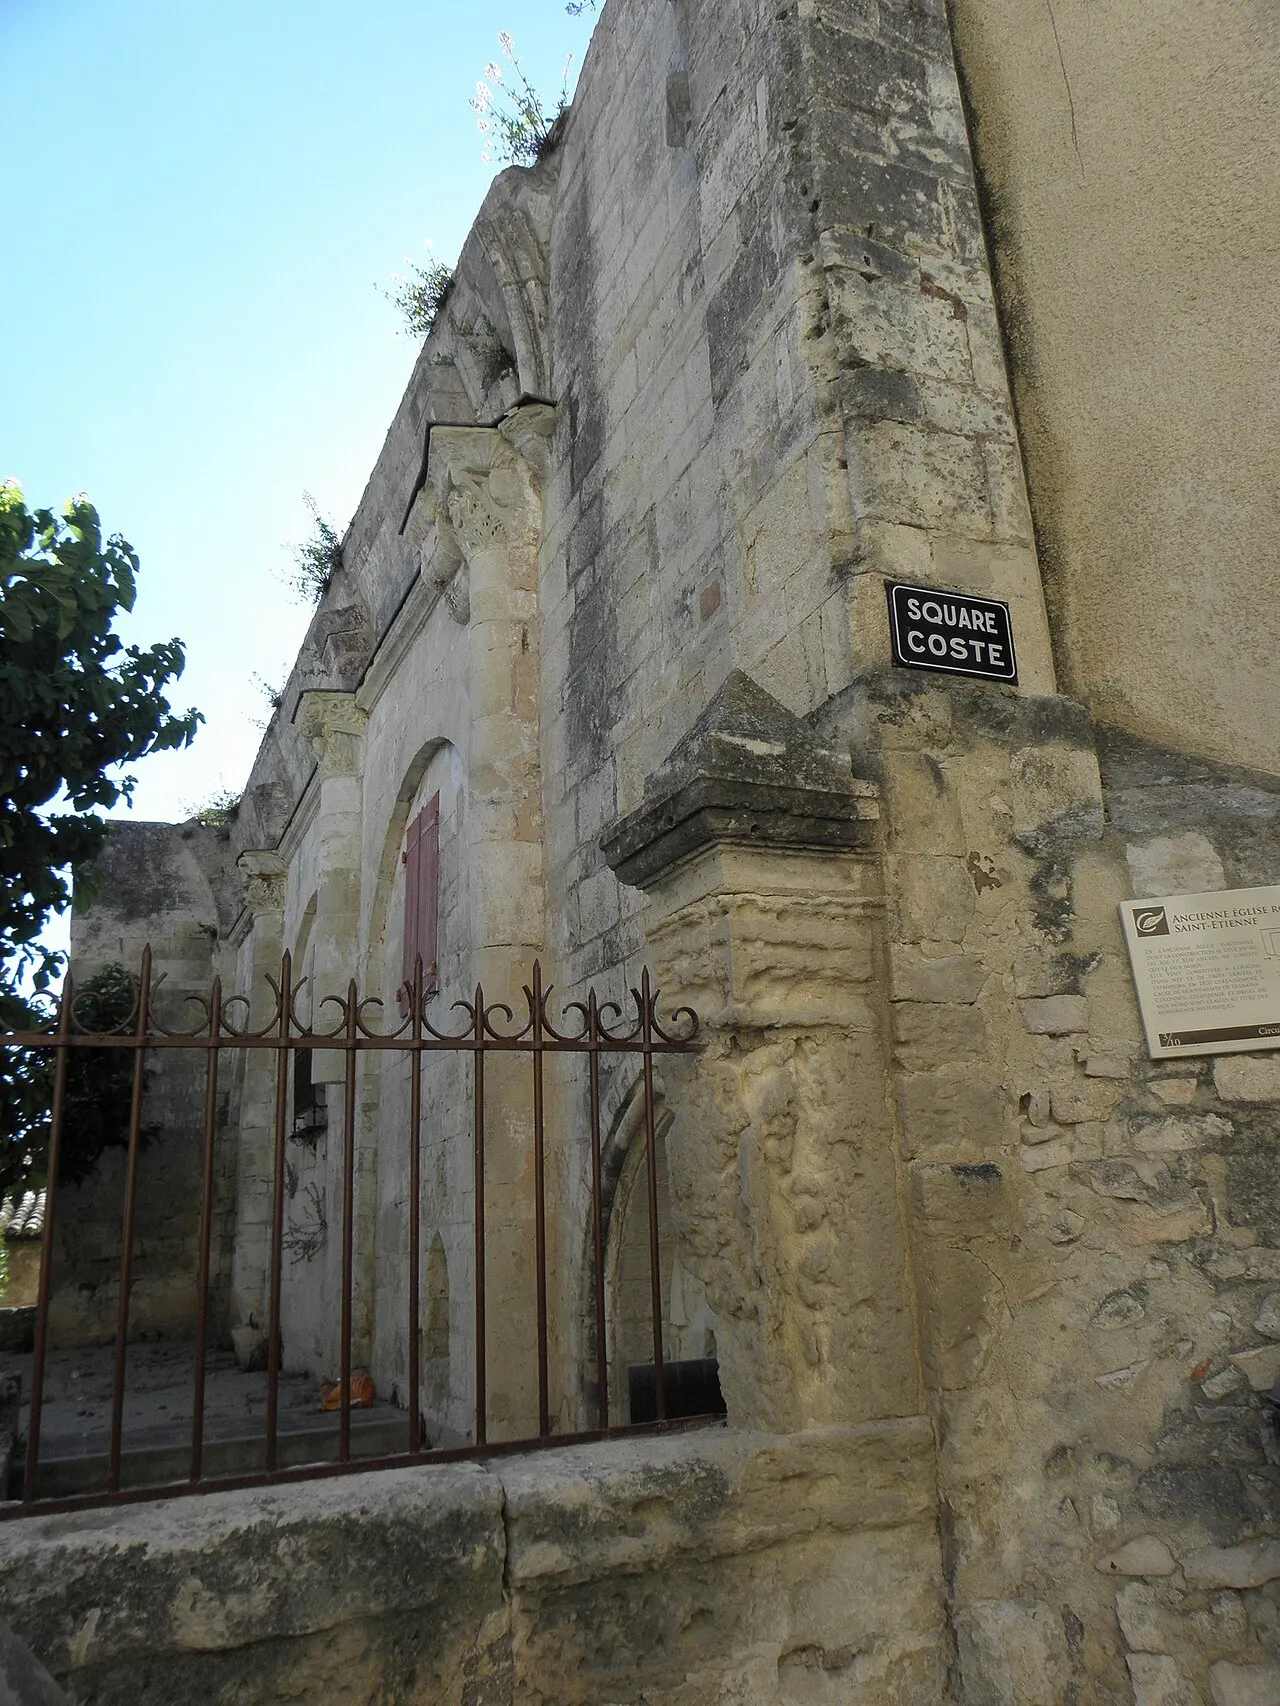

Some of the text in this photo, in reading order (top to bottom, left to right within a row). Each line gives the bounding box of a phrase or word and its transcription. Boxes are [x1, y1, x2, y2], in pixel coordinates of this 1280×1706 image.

[907, 598, 998, 634] SQUARE
[907, 630, 1005, 667] COSTE
[1173, 910, 1230, 923] ANCIENNE
[1232, 905, 1268, 917] ÉGLISE
